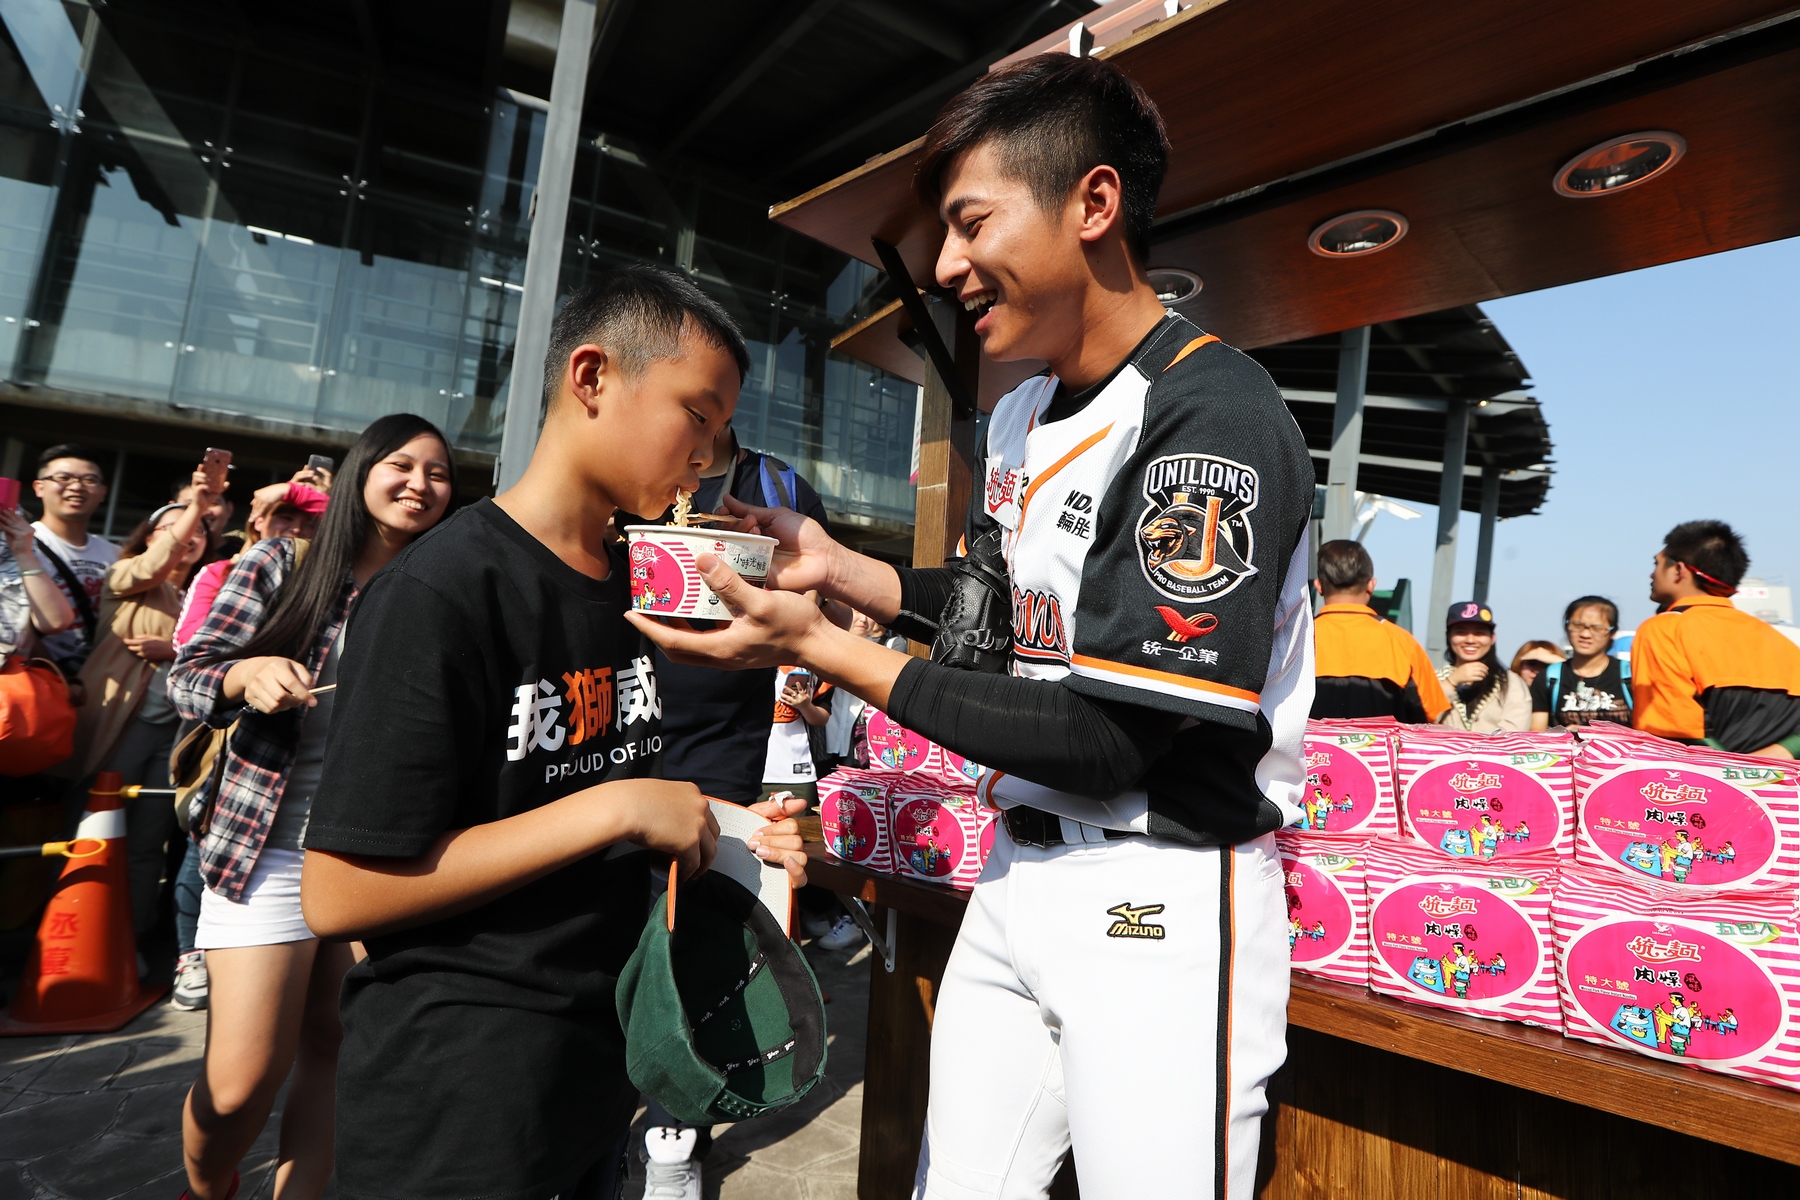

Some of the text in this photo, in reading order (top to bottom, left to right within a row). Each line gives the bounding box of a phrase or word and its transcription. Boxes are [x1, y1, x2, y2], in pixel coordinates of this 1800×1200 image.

[1149, 460, 1254, 503] UNILIONS
[1056, 511, 1091, 540] 輪胎
[1153, 571, 1229, 594] PRO BASEBALL TEAM
[1142, 640, 1219, 665] 統一企業
[507, 655, 662, 761] 我獅威
[545, 752, 604, 783] PROUD
[609, 742, 637, 764] OF
[1722, 766, 1780, 780] 五包入
[1448, 772, 1502, 794] 統一麵
[1640, 782, 1707, 805] 統一麵
[1418, 895, 1478, 919] 統一麵
[1715, 921, 1774, 936] 五包入
[1627, 936, 1702, 963] 統一麵
[1585, 975, 1630, 991] 特大號
[1634, 965, 1682, 988] 肉燥
